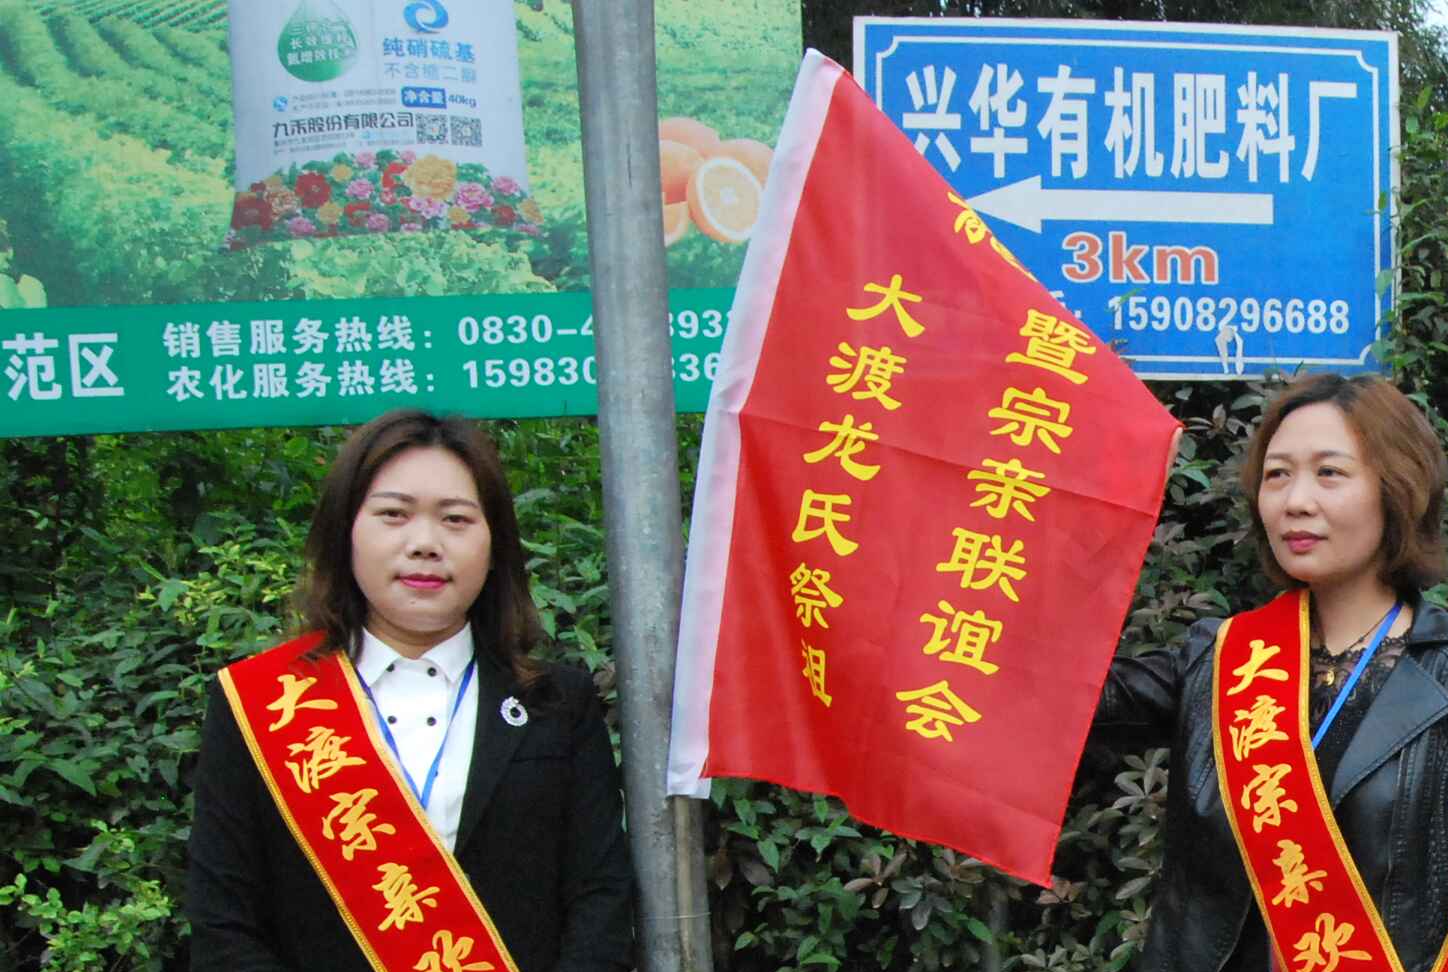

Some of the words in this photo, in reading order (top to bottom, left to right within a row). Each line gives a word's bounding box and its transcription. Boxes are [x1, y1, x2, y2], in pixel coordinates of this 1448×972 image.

[272, 112, 414, 138] 九禾股份有限公司
[903, 64, 1357, 182] 兴华有机肥料厂
[1062, 231, 1219, 285] 3km
[163, 315, 432, 358] 销售服务热线：
[1108, 296, 1349, 334] 15908296688
[2, 332, 124, 400] 范区
[166, 359, 434, 401] 农化服务热线：
[790, 274, 925, 707] 大渡龙氏祭祖
[897, 309, 1097, 742] 暨宗亲联谊会
